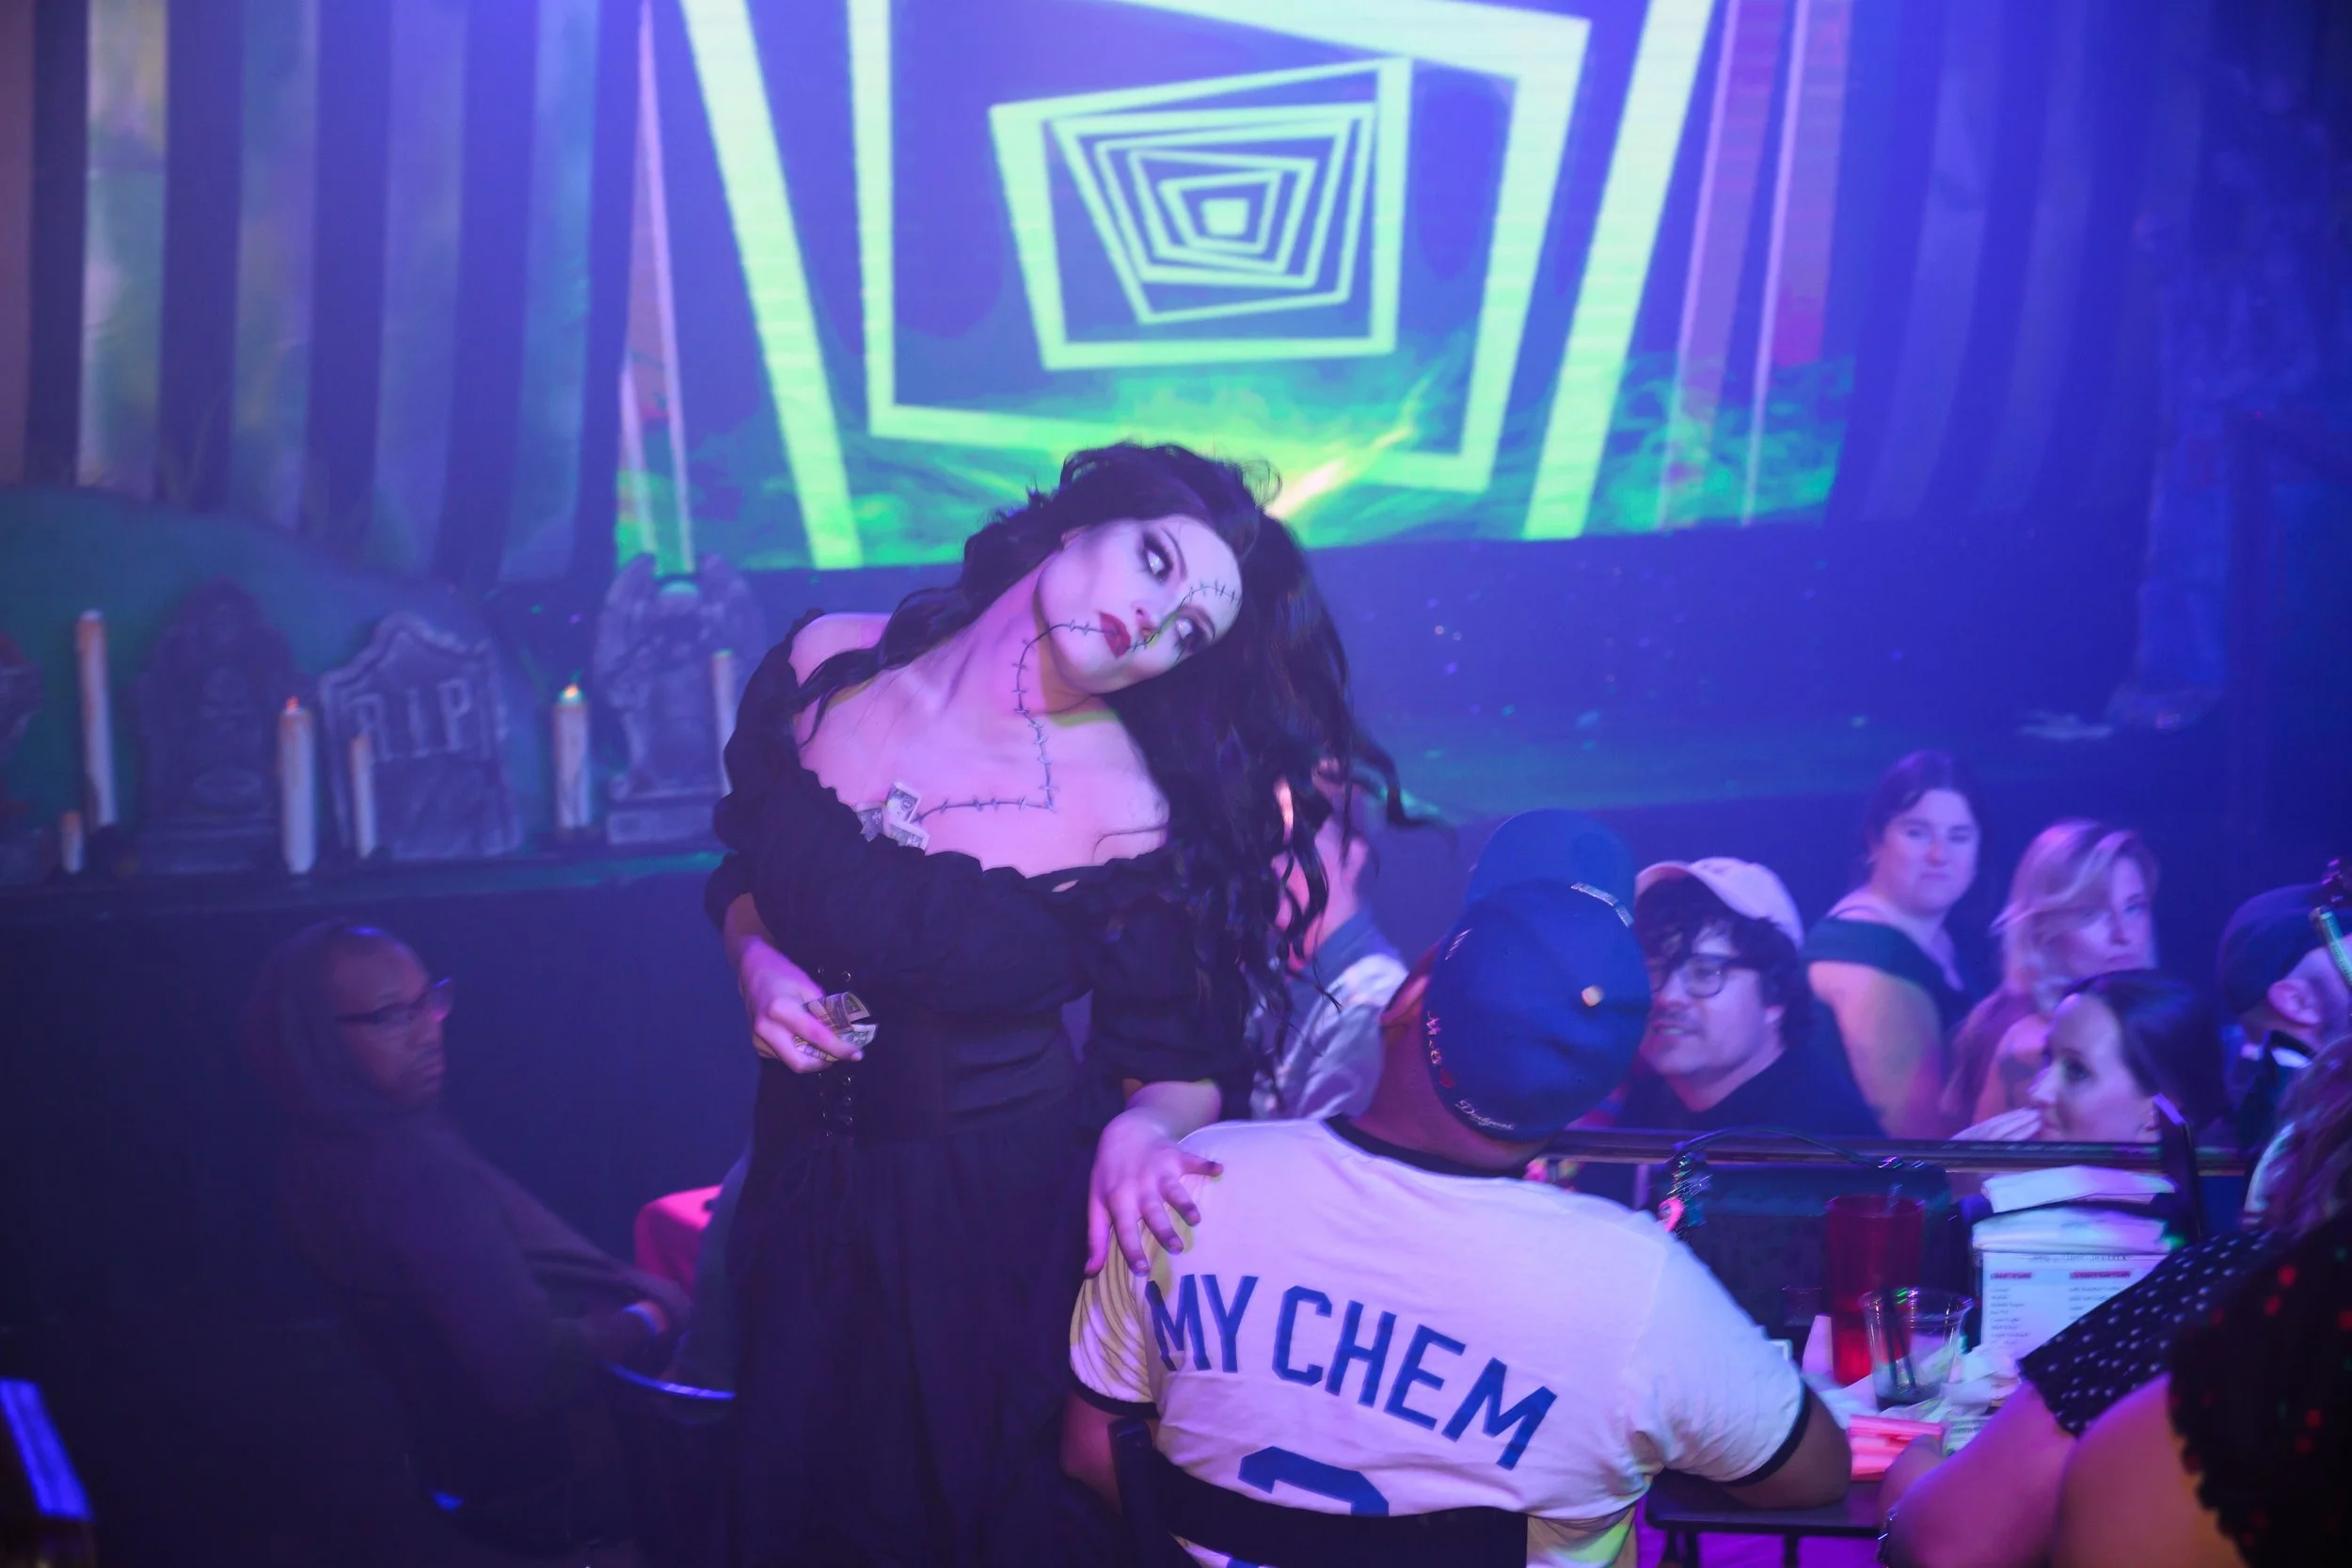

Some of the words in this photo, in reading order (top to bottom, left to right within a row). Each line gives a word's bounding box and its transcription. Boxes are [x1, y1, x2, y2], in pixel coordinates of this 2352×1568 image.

[349, 677, 473, 763] RIP
[1145, 1274, 1259, 1372] MY
[1272, 1285, 1558, 1470] CHEM
